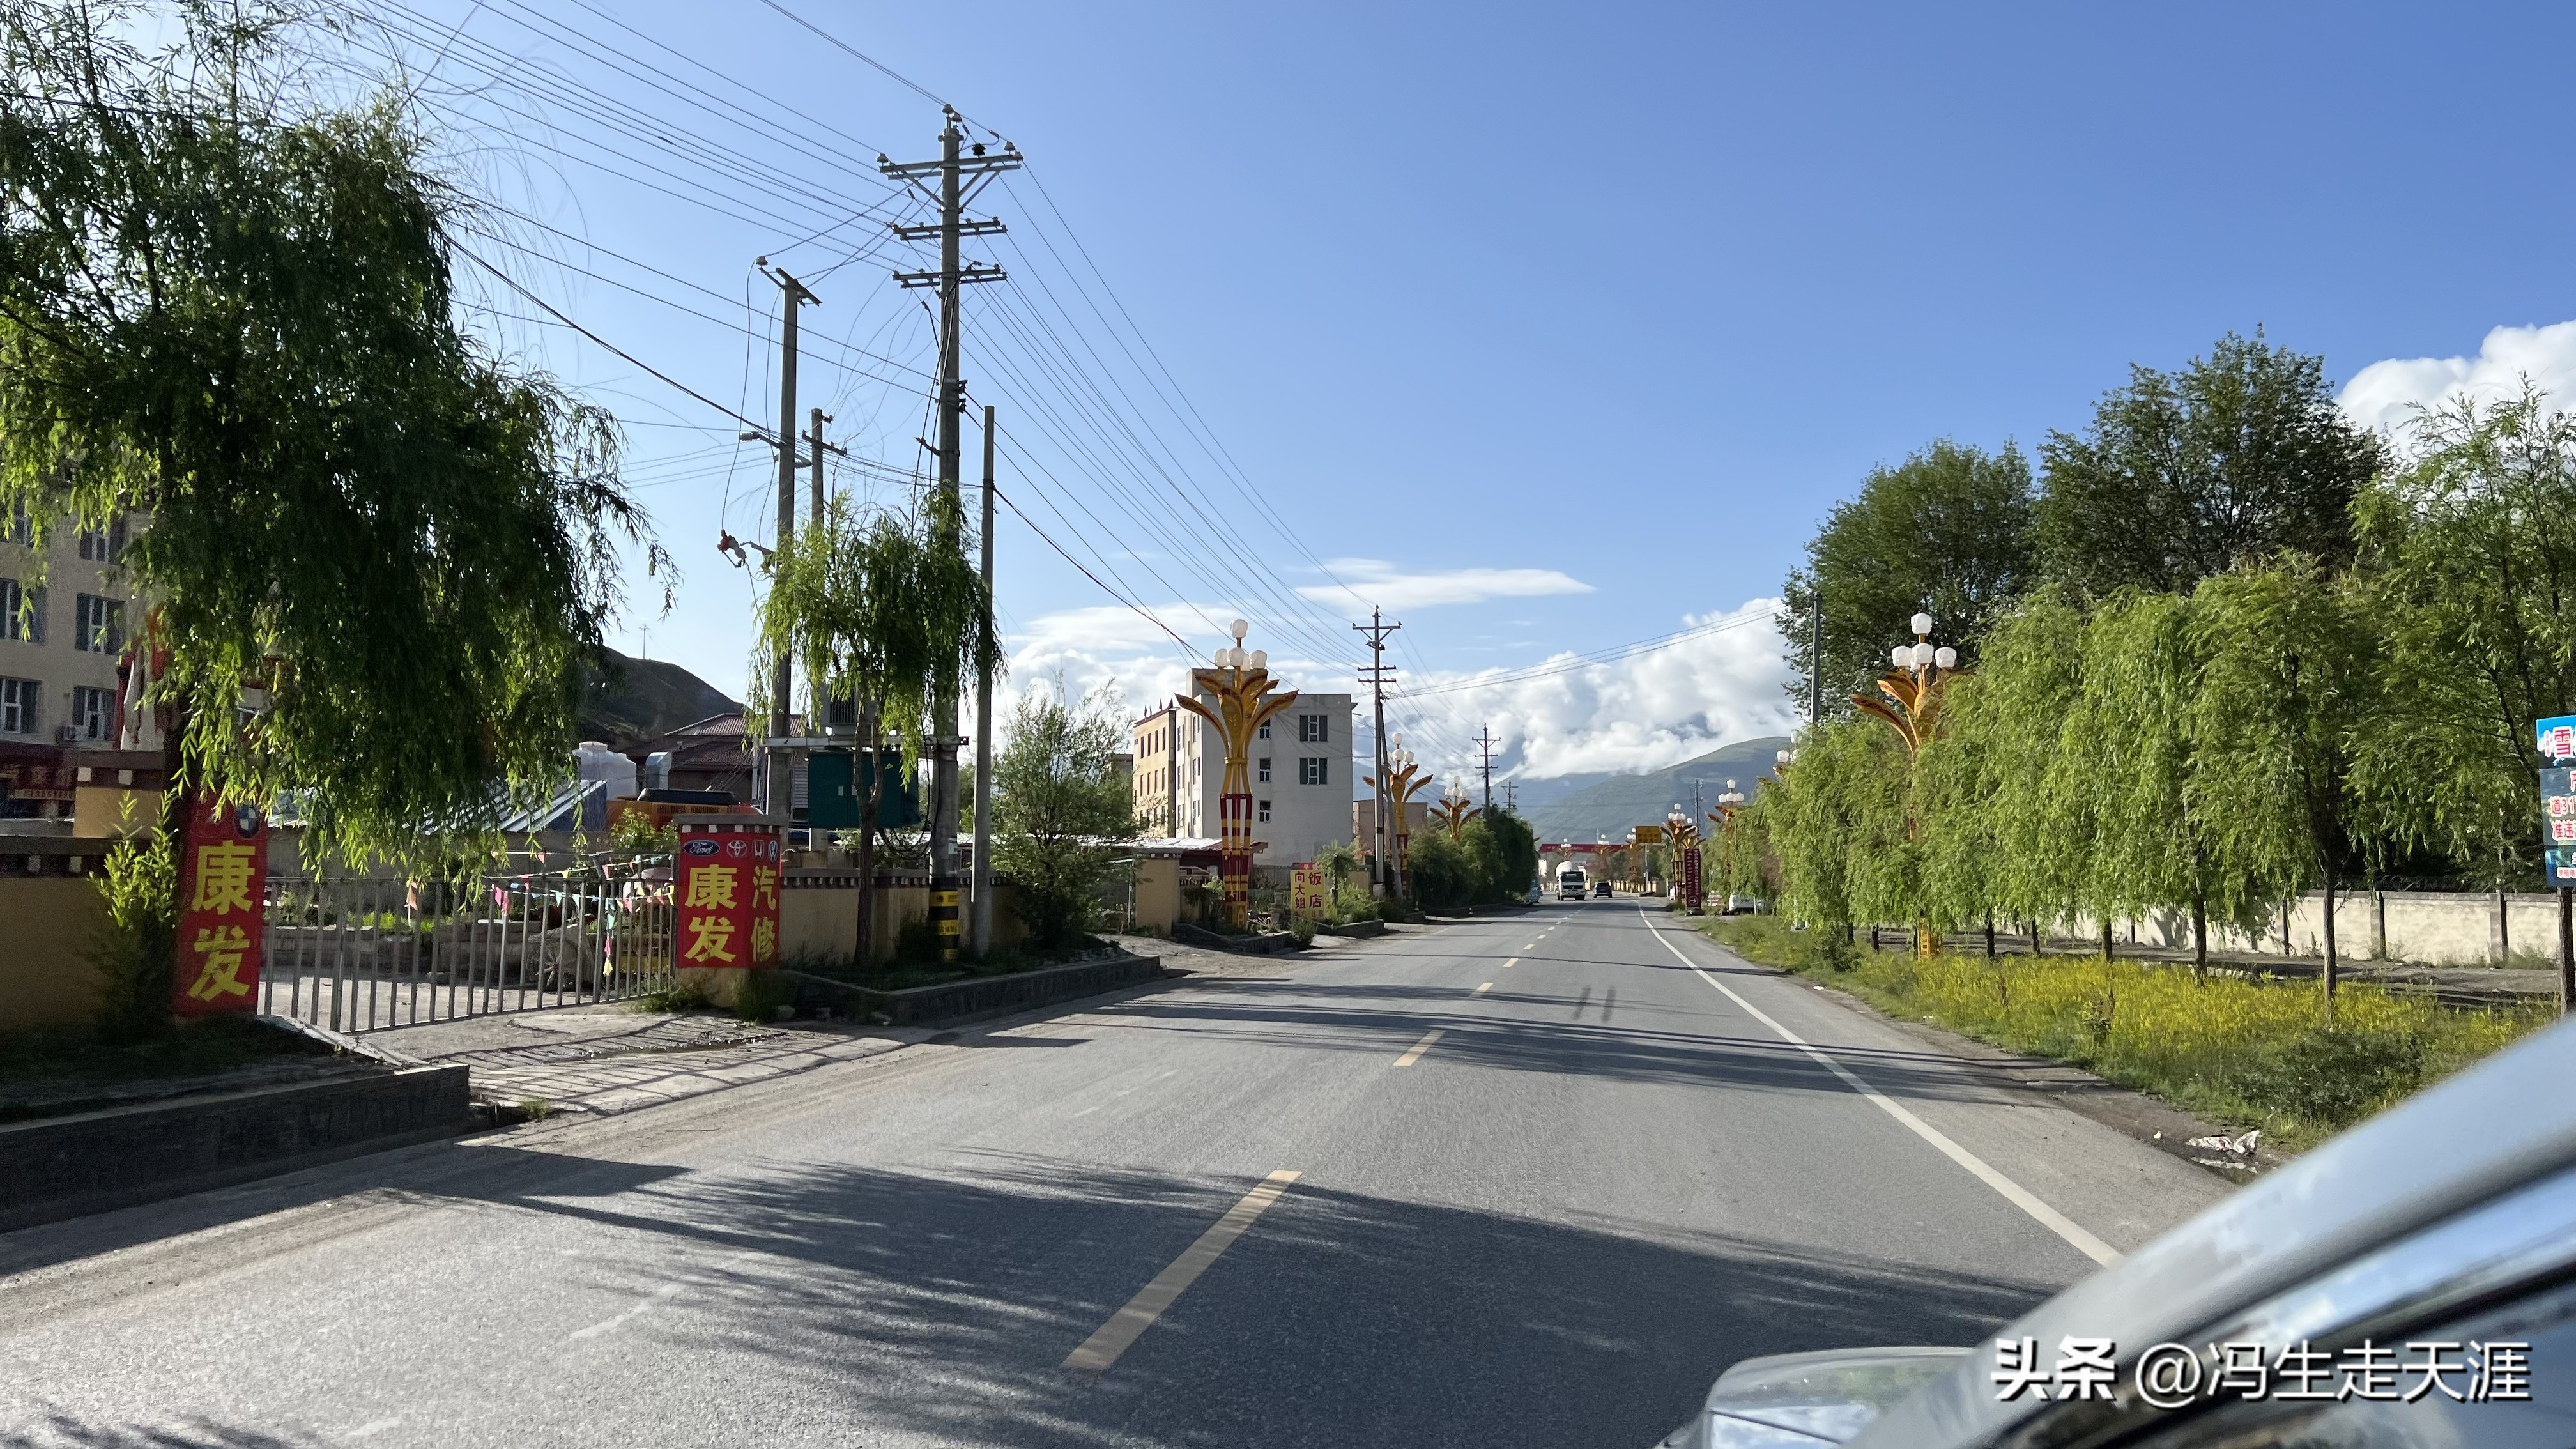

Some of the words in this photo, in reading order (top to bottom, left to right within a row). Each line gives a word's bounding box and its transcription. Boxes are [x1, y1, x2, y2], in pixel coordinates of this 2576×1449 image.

[2554, 728, 2571, 755] 雪
[2552, 822, 2576, 838] 准违
[1294, 871, 1306, 909] 向大姐
[1308, 871, 1322, 908] 饭店
[188, 839, 255, 1002] 康发
[684, 864, 739, 963] 康发
[750, 865, 777, 962] 汽修
